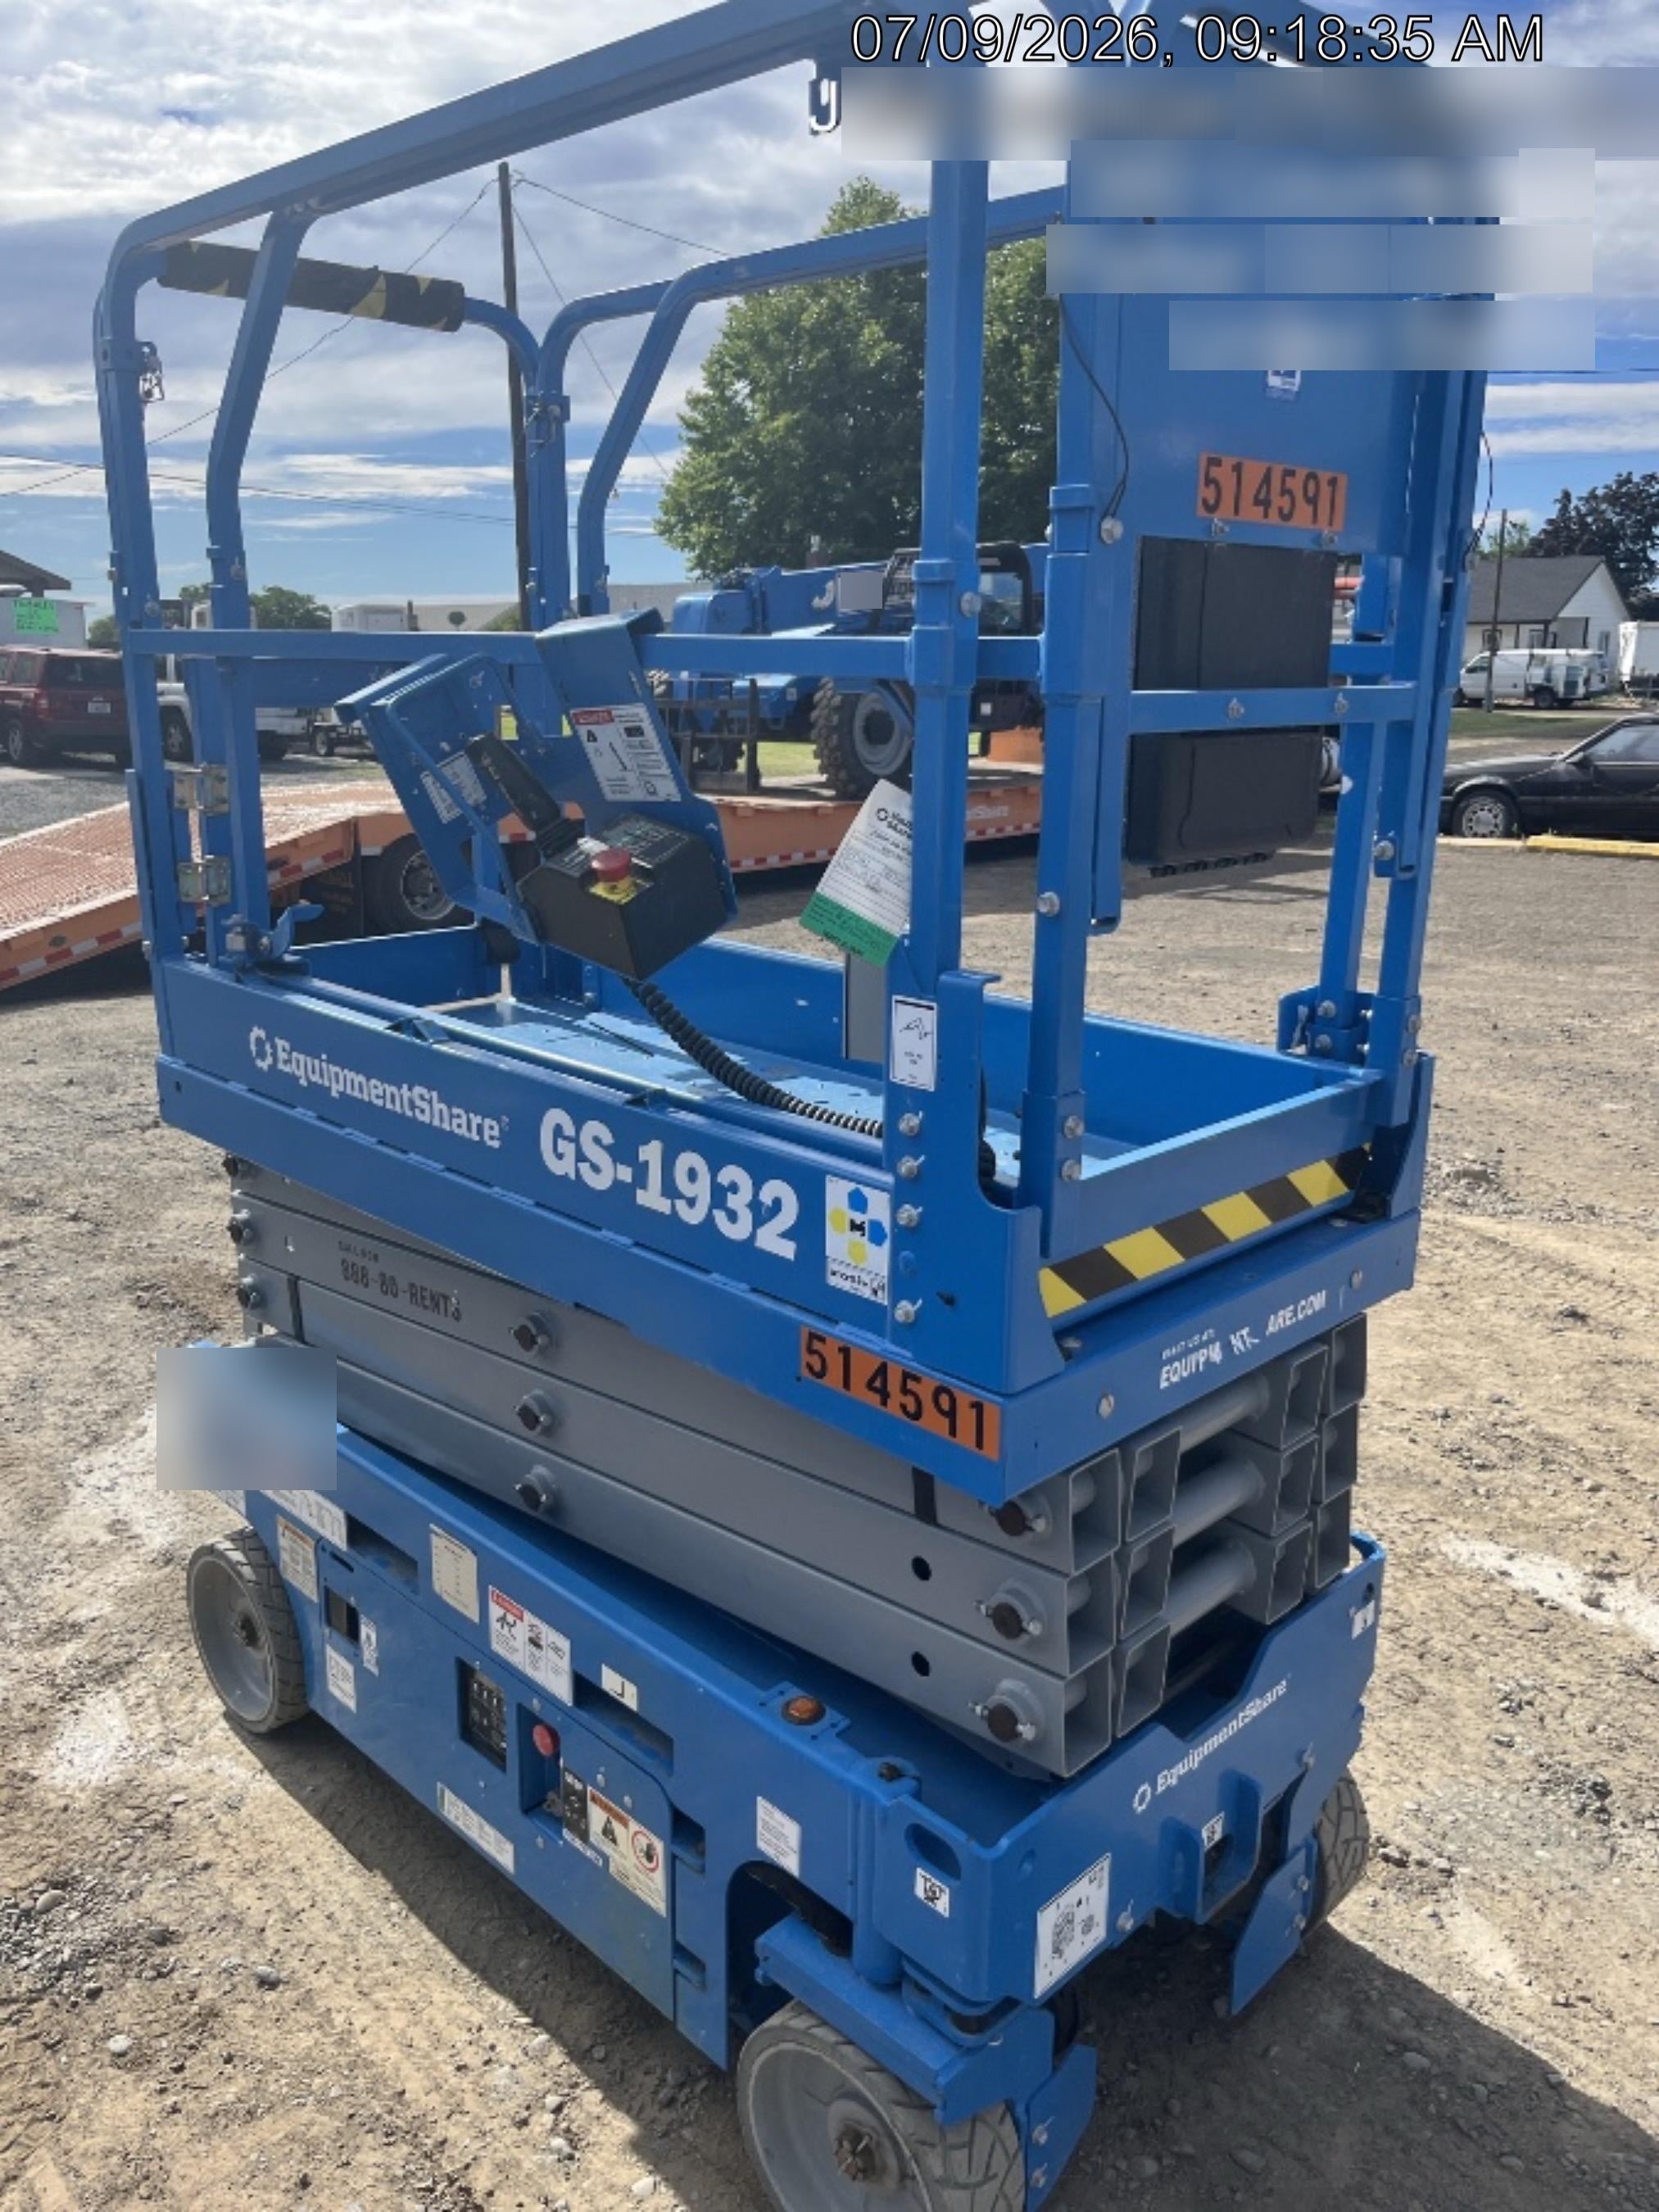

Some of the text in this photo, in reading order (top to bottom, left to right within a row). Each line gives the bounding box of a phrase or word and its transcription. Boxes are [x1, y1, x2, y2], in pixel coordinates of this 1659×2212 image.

[1201, 456, 1339, 528] 514591
[274, 1036, 502, 1149] EquipmentShare
[539, 1107, 800, 1262] GS-1932
[805, 1329, 985, 1451] 514591
[1155, 1678, 1288, 1795] EquipmentShare
